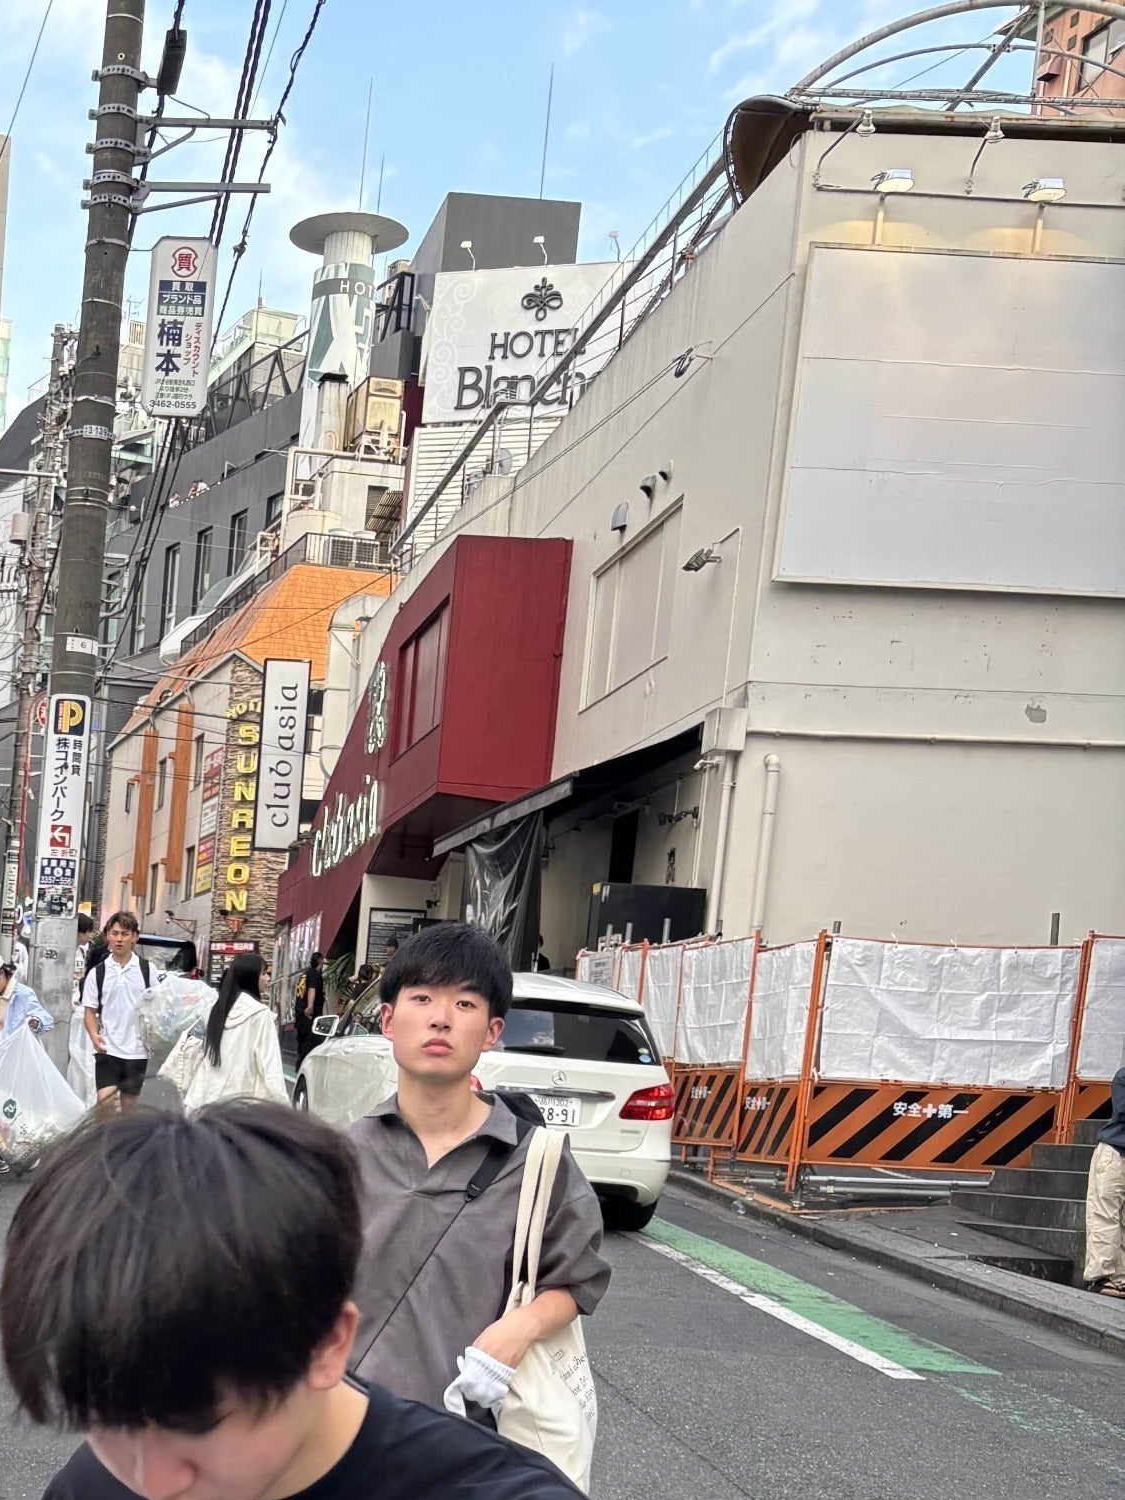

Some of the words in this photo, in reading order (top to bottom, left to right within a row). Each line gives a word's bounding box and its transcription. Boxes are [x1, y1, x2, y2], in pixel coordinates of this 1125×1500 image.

[177, 254, 192, 271] 質
[162, 294, 202, 305] ブランド品
[155, 318, 185, 377] 楠本
[183, 333, 193, 366] ショップ
[488, 328, 586, 360] HOTEL
[149, 399, 197, 409] 3462-0555
[278, 683, 299, 751] asia
[265, 760, 293, 828] club
[225, 724, 260, 912] SUNREON
